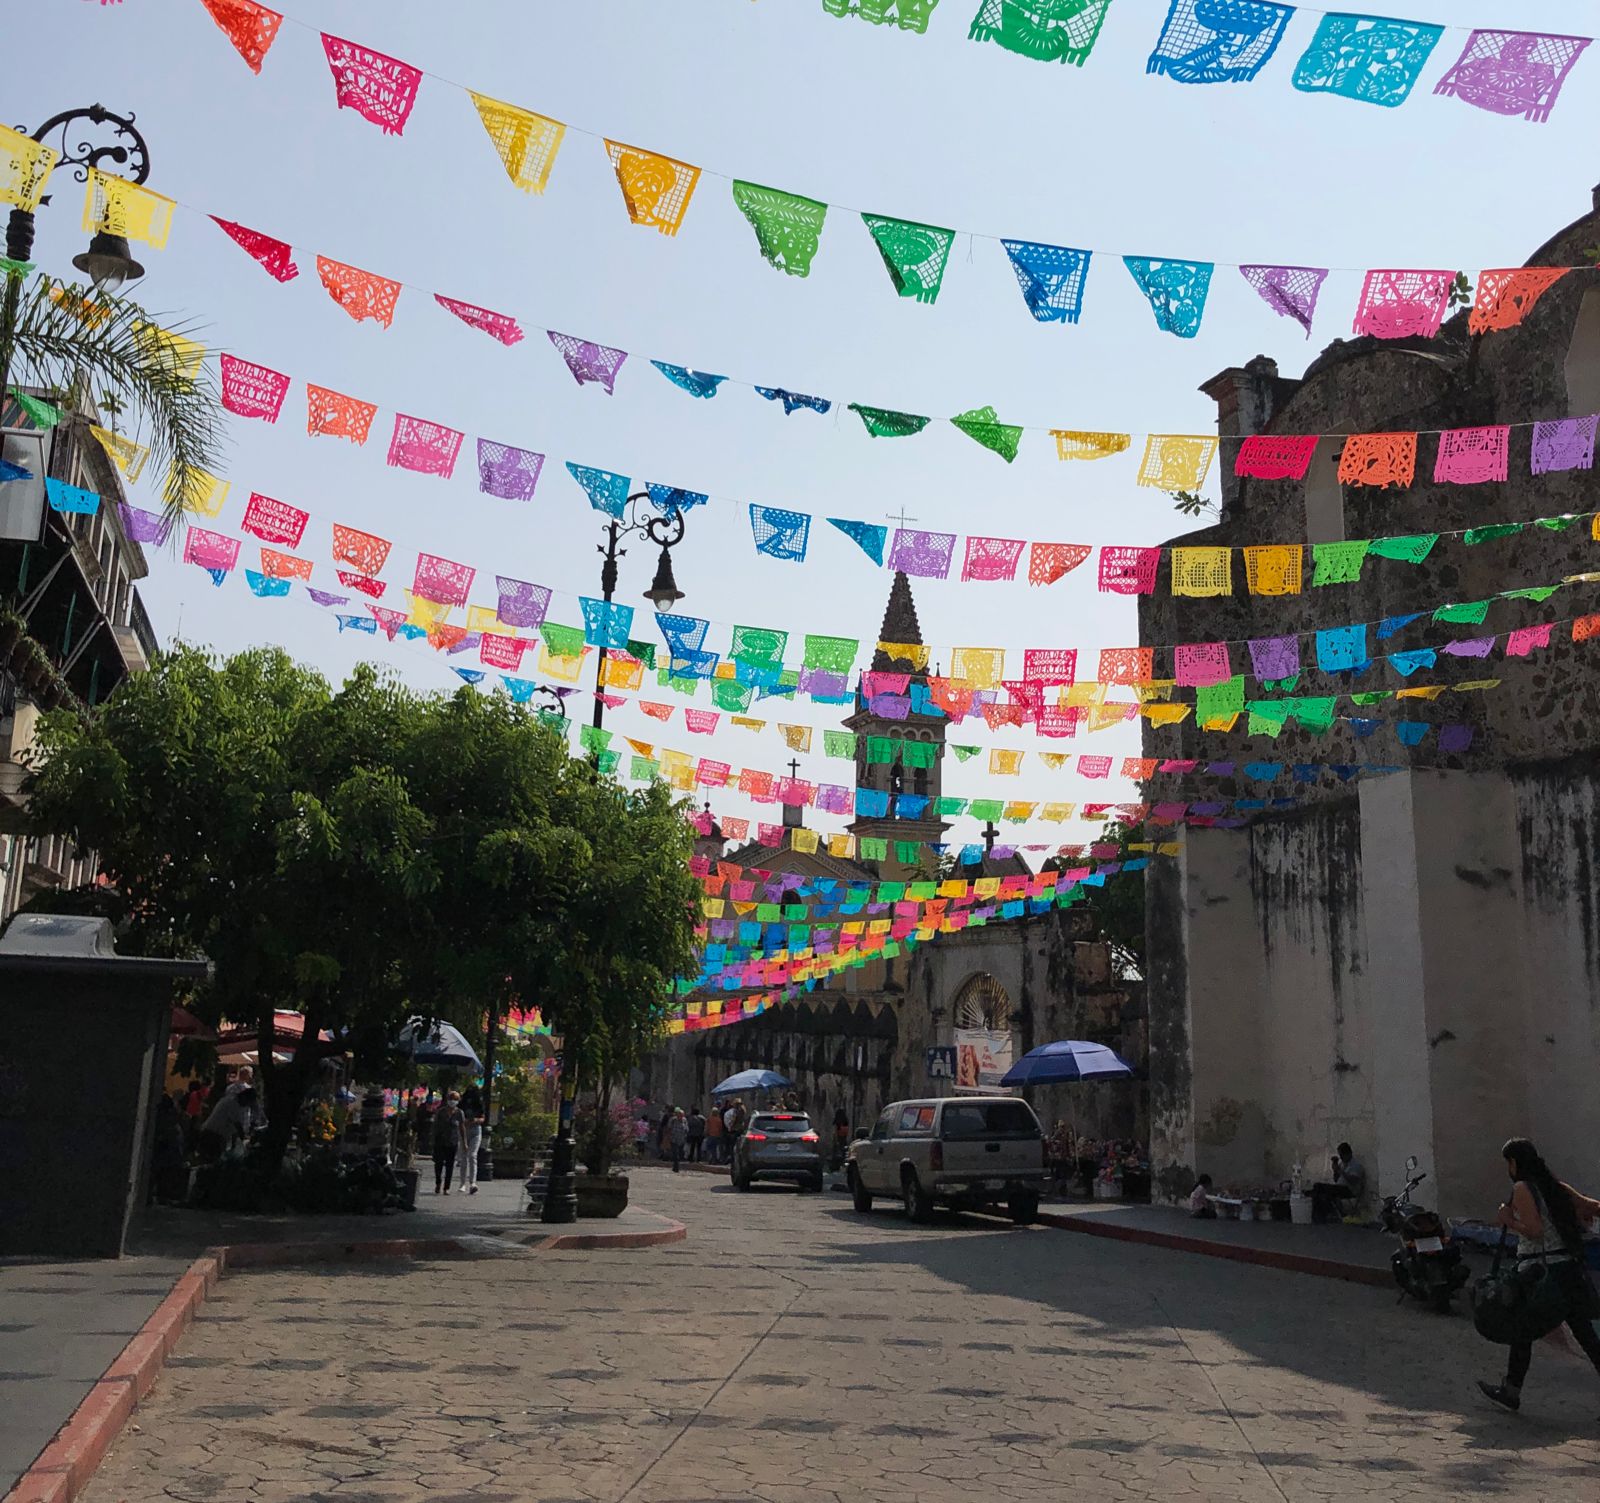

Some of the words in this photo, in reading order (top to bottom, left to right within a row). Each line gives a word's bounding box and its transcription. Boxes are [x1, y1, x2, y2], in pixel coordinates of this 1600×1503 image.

[235, 360, 254, 377] DIA
[257, 368, 270, 382] DE
[224, 380, 276, 405] UERTOS
[263, 499, 281, 512] DIA
[282, 504, 294, 517] DE
[249, 509, 299, 535] MUERTOS
[1036, 650, 1051, 660] DIA
[1052, 650, 1064, 660] DE
[1028, 665, 1070, 675] MUERTOS
